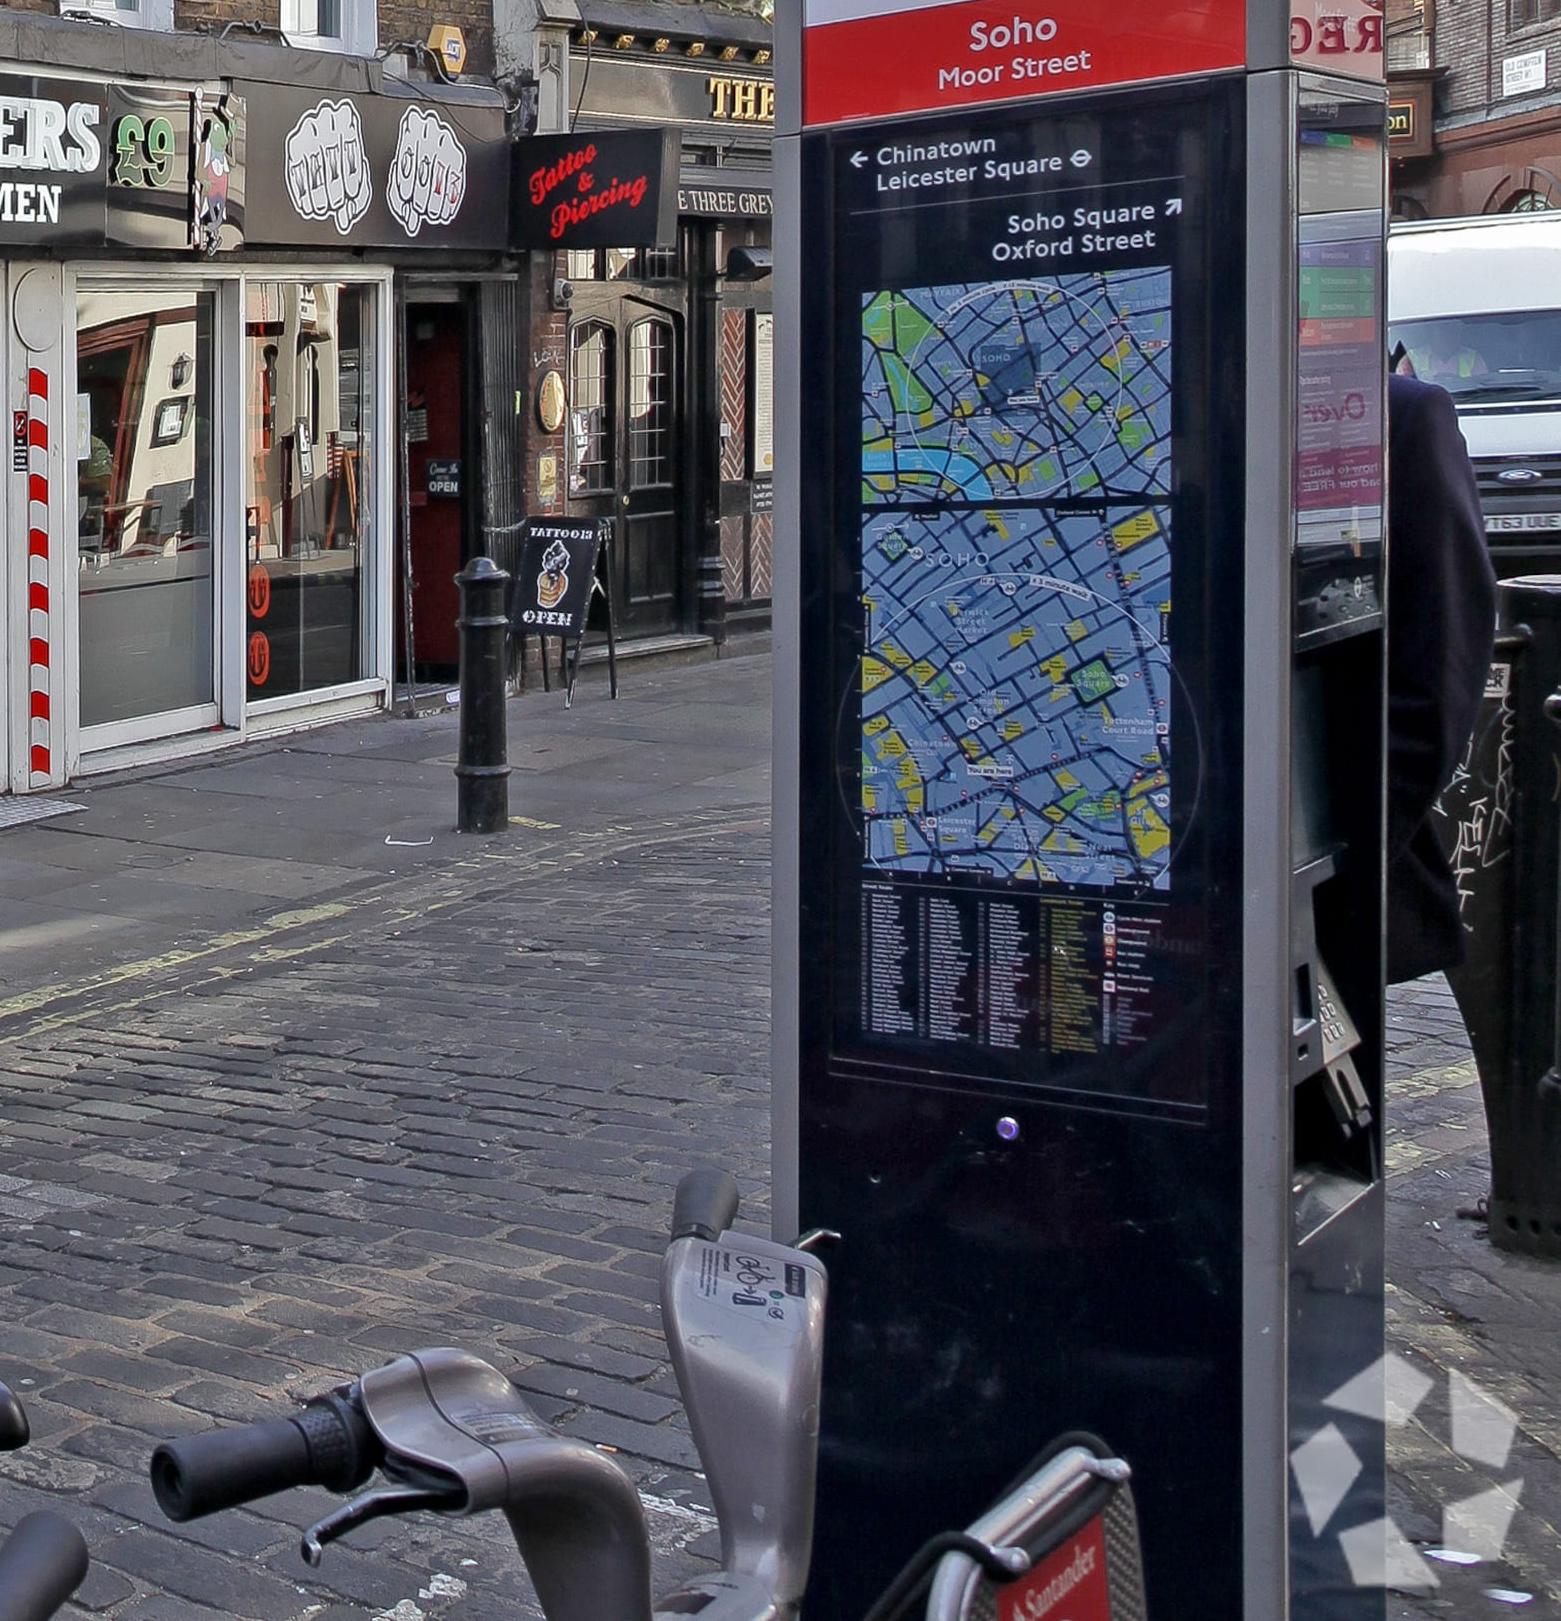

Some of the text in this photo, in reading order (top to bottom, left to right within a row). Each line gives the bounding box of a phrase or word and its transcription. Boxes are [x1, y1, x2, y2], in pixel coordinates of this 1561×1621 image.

[969, 15, 1058, 52] Soho
[937, 49, 1092, 90] Moor Street
[709, 76, 774, 122] THE
[115, 113, 175, 190] £9
[876, 137, 996, 167] Chinatown
[529, 143, 598, 206] Tattoo
[578, 171, 594, 193] &
[877, 154, 1063, 192] Leicester Square
[550, 174, 647, 240] Piercing
[690, 189, 737, 214] THREE
[1007, 203, 1156, 235] Soho Square
[991, 229, 1157, 262] Oxford Street
[982, 354, 1011, 363] SOHO
[429, 480, 458, 492] OPEN
[925, 552, 990, 568] SOHO
[1045, 578, 1071, 593] minute
[522, 609, 573, 627] OPEN
[1081, 669, 1106, 678] Soho
[1102, 726, 1154, 735] Court Road
[1103, 717, 1154, 726] Tottenham
[1026, 1545, 1096, 1617] Santander
